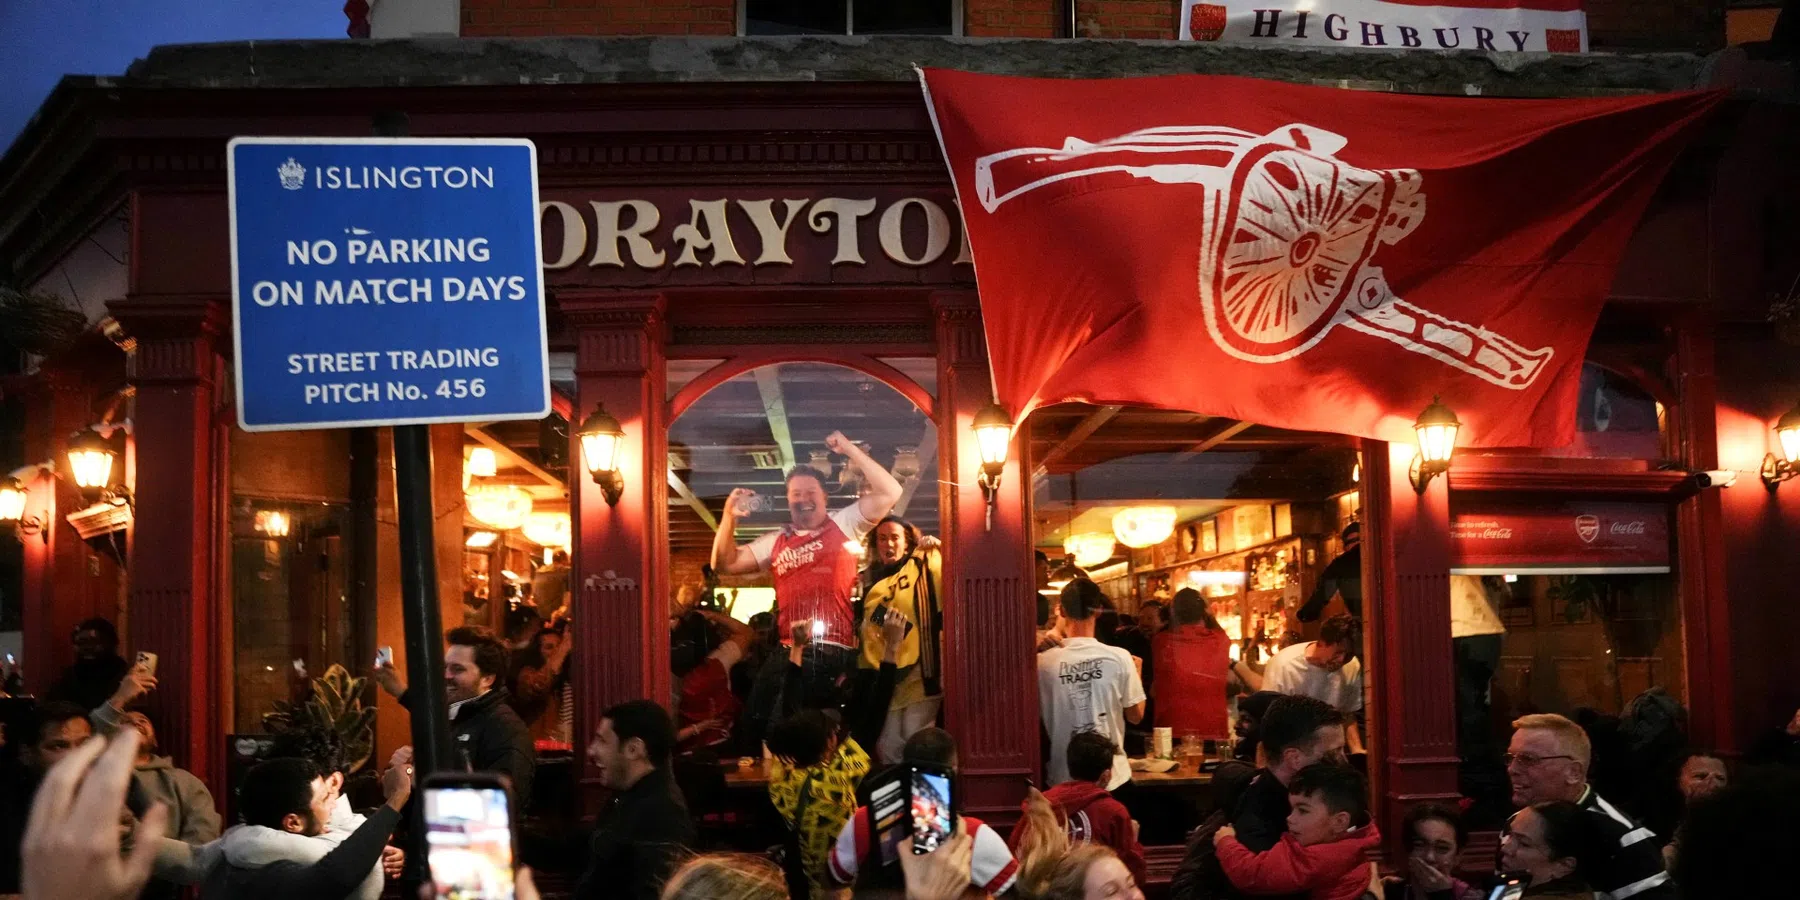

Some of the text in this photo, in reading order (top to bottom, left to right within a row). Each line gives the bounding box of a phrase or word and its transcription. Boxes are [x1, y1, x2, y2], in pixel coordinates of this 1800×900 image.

[1250, 9, 1530, 52] HIGHBURY
[316, 166, 494, 189] ISLINGTON
[540, 197, 974, 268] DRAYTO
[287, 237, 491, 265] NO PARKING
[252, 276, 526, 307] ON MATCH DAYS
[288, 347, 499, 374] STREET TRADING
[304, 378, 487, 404] PITCH No. 456
[1059, 669, 1103, 685] TRACKS
